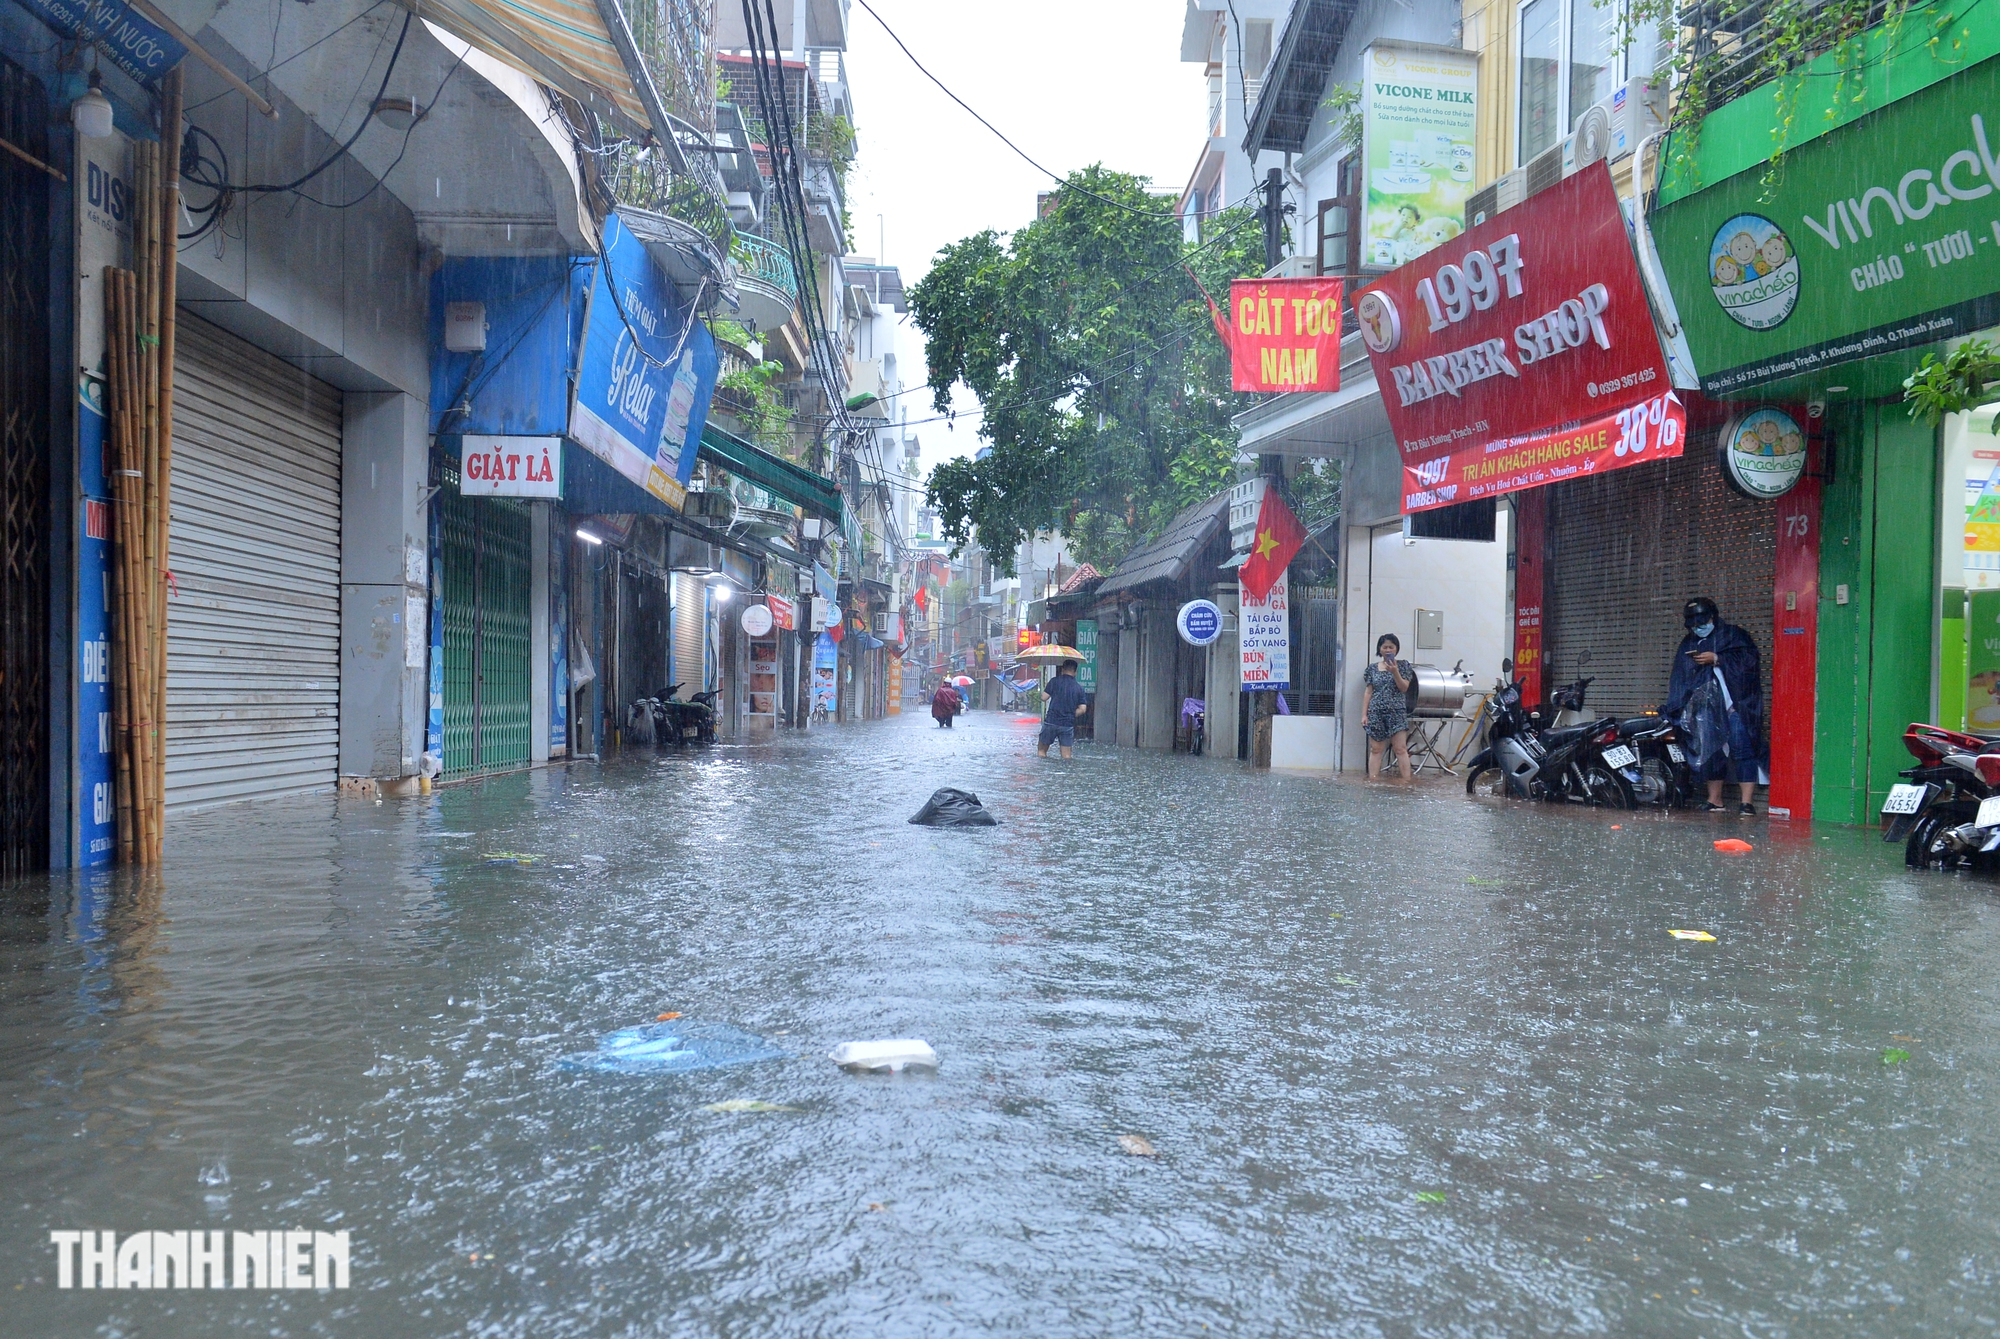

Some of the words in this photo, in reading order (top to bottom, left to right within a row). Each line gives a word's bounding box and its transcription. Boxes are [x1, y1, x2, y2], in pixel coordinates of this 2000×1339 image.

[113, 21, 165, 67] NƯỚC
[1404, 64, 1439, 74] VICONE
[1441, 68, 1472, 78] GROUP
[1375, 83, 1432, 100] VICONE
[1437, 89, 1474, 104] MILK
[1383, 104, 1397, 112] sung
[1851, 253, 1904, 292] CHÁO
[1922, 229, 1975, 268] TƯƠI
[1415, 233, 1524, 334] 1997
[1719, 269, 1797, 305] vinacháo
[625, 287, 643, 319] TIỆM
[641, 306, 657, 336] GIẶT
[1239, 285, 1285, 336] CẮT
[1291, 290, 1337, 337] TÓC
[1363, 301, 1375, 313] 1997
[1390, 337, 1521, 408] BARBER
[1514, 282, 1611, 366] SHOP
[1707, 381, 1721, 391] Địa
[1736, 371, 1747, 383] Số
[1747, 370, 1757, 380] 75
[1756, 366, 1770, 377] Bùi
[1770, 361, 1796, 374] Xương
[1796, 353, 1820, 369] Trạch,
[1820, 350, 1829, 360] P.
[1829, 342, 1862, 358] Khương
[1863, 335, 1888, 348] Đình,
[1888, 322, 1927, 342] Q.Thanh
[1927, 316, 1954, 331] Xuân
[607, 324, 656, 424] Relax
[1261, 347, 1318, 385] NAM
[1599, 378, 1621, 395] 0329
[1621, 372, 1639, 389] 367
[1639, 367, 1657, 384] 425
[1419, 437, 1430, 450] Bùi
[1451, 425, 1473, 441] Trạch
[1475, 420, 1489, 433] HN
[1614, 395, 1677, 457] 30%
[1462, 463, 1479, 482] TRI
[1480, 457, 1495, 478] ÂN
[1497, 447, 1536, 474] KHÁCH
[1537, 439, 1571, 463] HÀNG
[1573, 430, 1608, 455] SALE
[1485, 438, 1508, 454] MỪNG
[1509, 434, 1529, 447] SINH
[467, 445, 520, 487] GIẶT
[525, 447, 554, 482] LÀ
[1416, 455, 1451, 487] 1997
[1736, 454, 1802, 471] vinacháo
[1469, 485, 1484, 498] Dịch
[1486, 482, 1496, 494] Vụ
[1497, 478, 1511, 490] Hoá
[1511, 472, 1529, 488] Chất
[1529, 470, 1544, 483] Uốn
[1550, 464, 1577, 479] Nhuộm
[1406, 489, 1437, 509] BARBER
[1436, 484, 1458, 503] SHOP
[1786, 514, 1808, 537] 73
[1247, 613, 1260, 623] TÁI
[1271, 598, 1286, 610] GÀ
[1243, 636, 1260, 648] SỐT
[1261, 639, 1287, 647] VANG
[1268, 625, 1281, 635] BÒ
[1243, 649, 1265, 663] BÚN
[1243, 665, 1269, 682] MIẾN
[1885, 800, 1917, 812] 045.54
